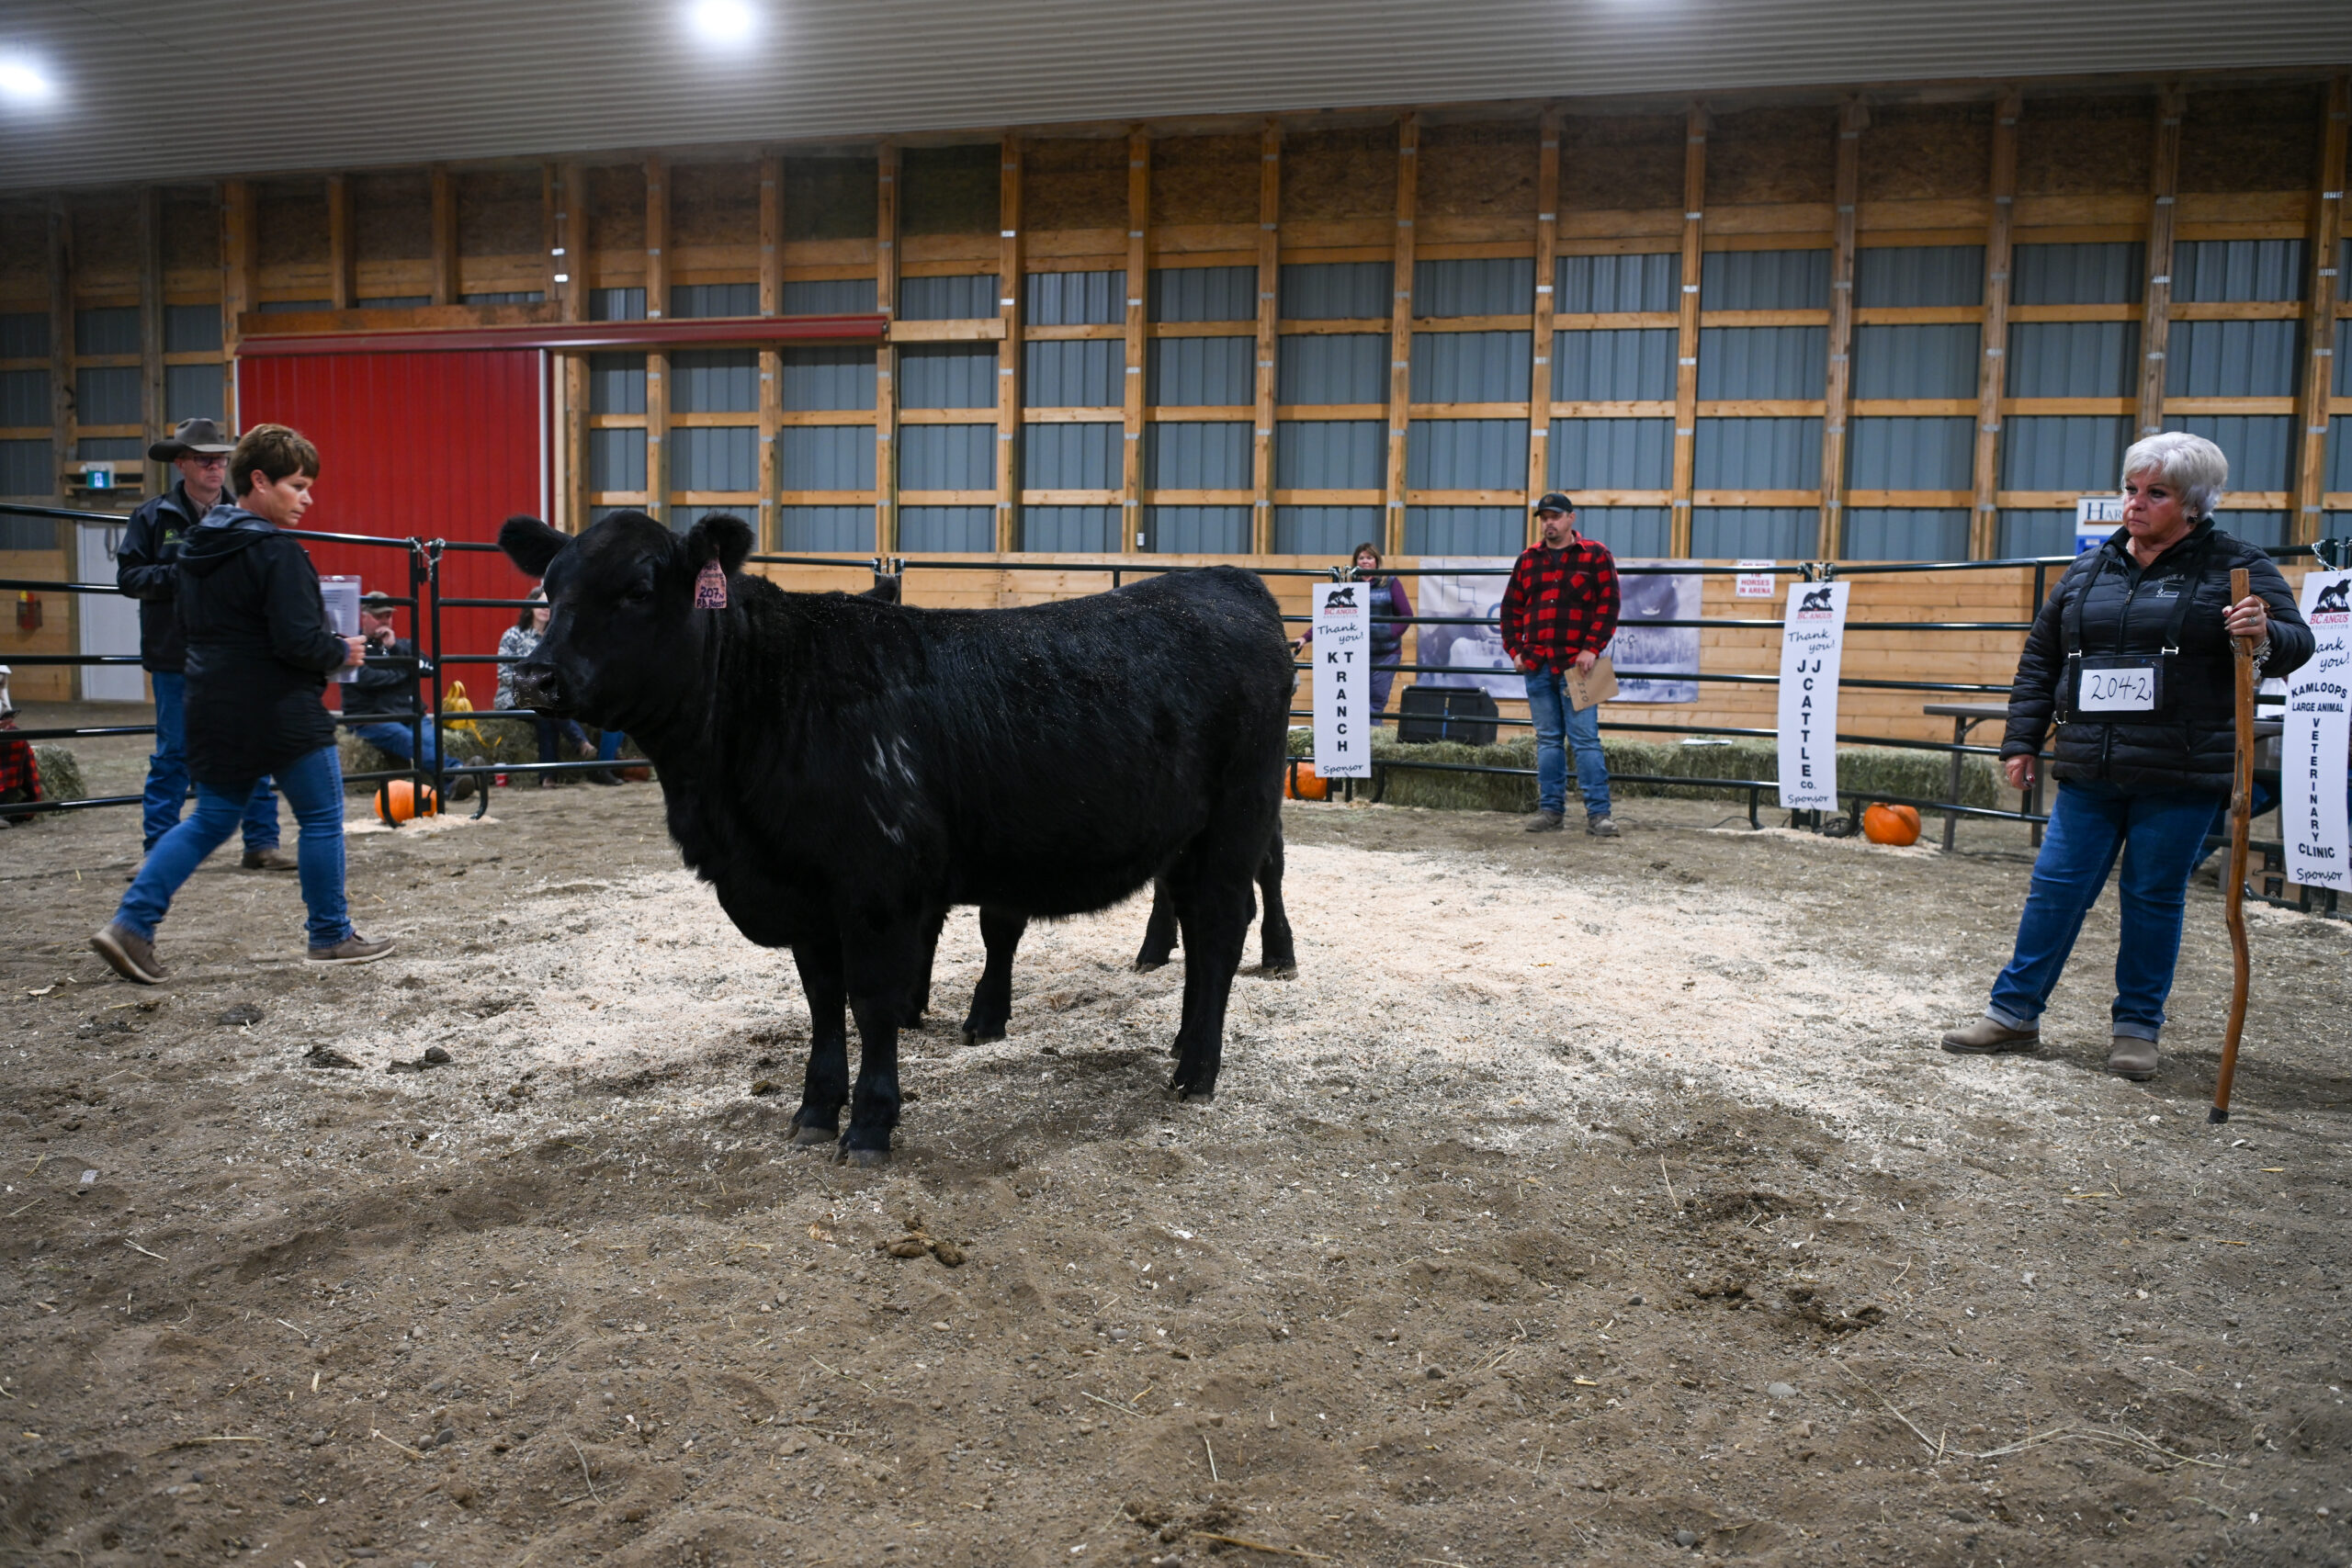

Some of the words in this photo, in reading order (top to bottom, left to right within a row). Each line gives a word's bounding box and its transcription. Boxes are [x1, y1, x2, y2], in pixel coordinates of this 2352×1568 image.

[1324, 607, 1335, 615] BC
[1797, 611, 1808, 620] BC
[1809, 612, 1832, 620] ANGUS
[2310, 614, 2324, 625] BC
[2324, 614, 2349, 624] ANGUS
[1317, 622, 1358, 635] Thank
[1787, 627, 1830, 642] Thank
[1339, 631, 1364, 645] you!
[2315, 637, 2346, 654] ank
[1808, 639, 1835, 654] you!
[2319, 651, 2350, 672] you!
[2291, 682, 2347, 698] KAMLOOPS
[1336, 671, 1347, 751] RANCH
[2292, 702, 2315, 711] LARGE
[2317, 703, 2344, 712] ANIMAL
[1801, 678, 1814, 777] CATTLE
[1323, 763, 1363, 774] Sponsor
[2310, 717, 2320, 842] VETERINARY
[1787, 794, 1829, 806] Sponsor
[2298, 843, 2335, 858] CLINIC
[2296, 867, 2343, 883] Sponsor
